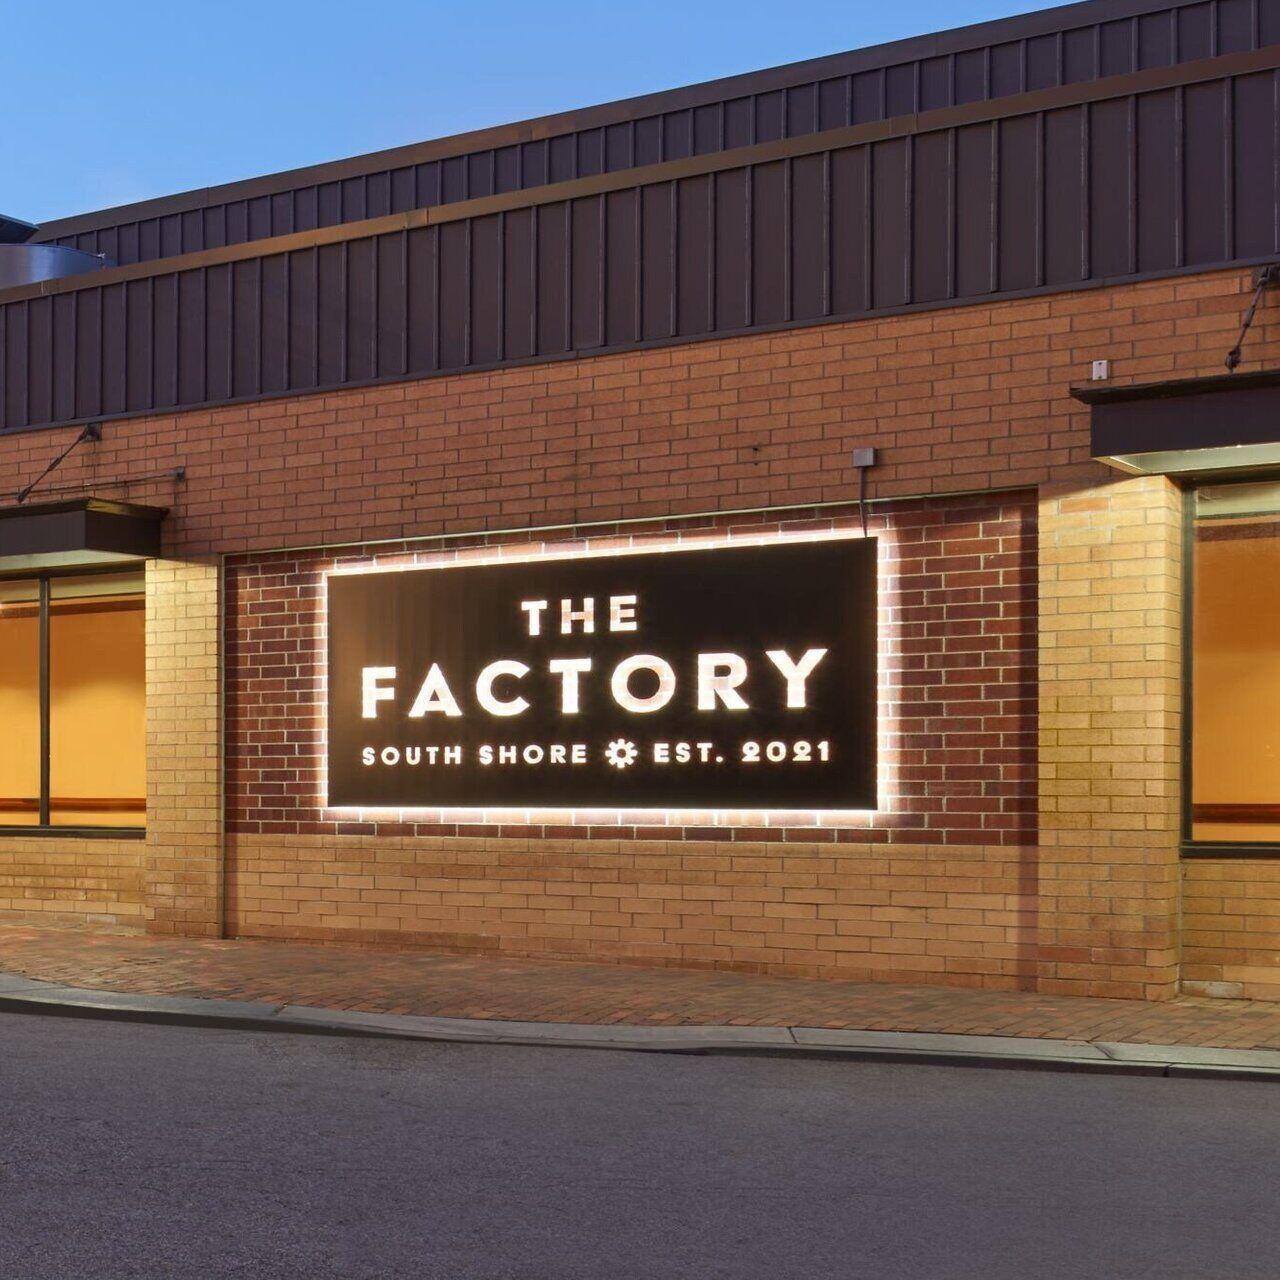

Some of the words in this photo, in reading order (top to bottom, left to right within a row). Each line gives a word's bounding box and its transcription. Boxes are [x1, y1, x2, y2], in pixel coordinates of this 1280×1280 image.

[521, 594, 638, 636] THE
[361, 648, 828, 719] FACTORY
[362, 746, 462, 766] SOUTH
[478, 744, 588, 766] SHORE
[653, 742, 724, 764] EST.
[741, 741, 829, 763] 2021
